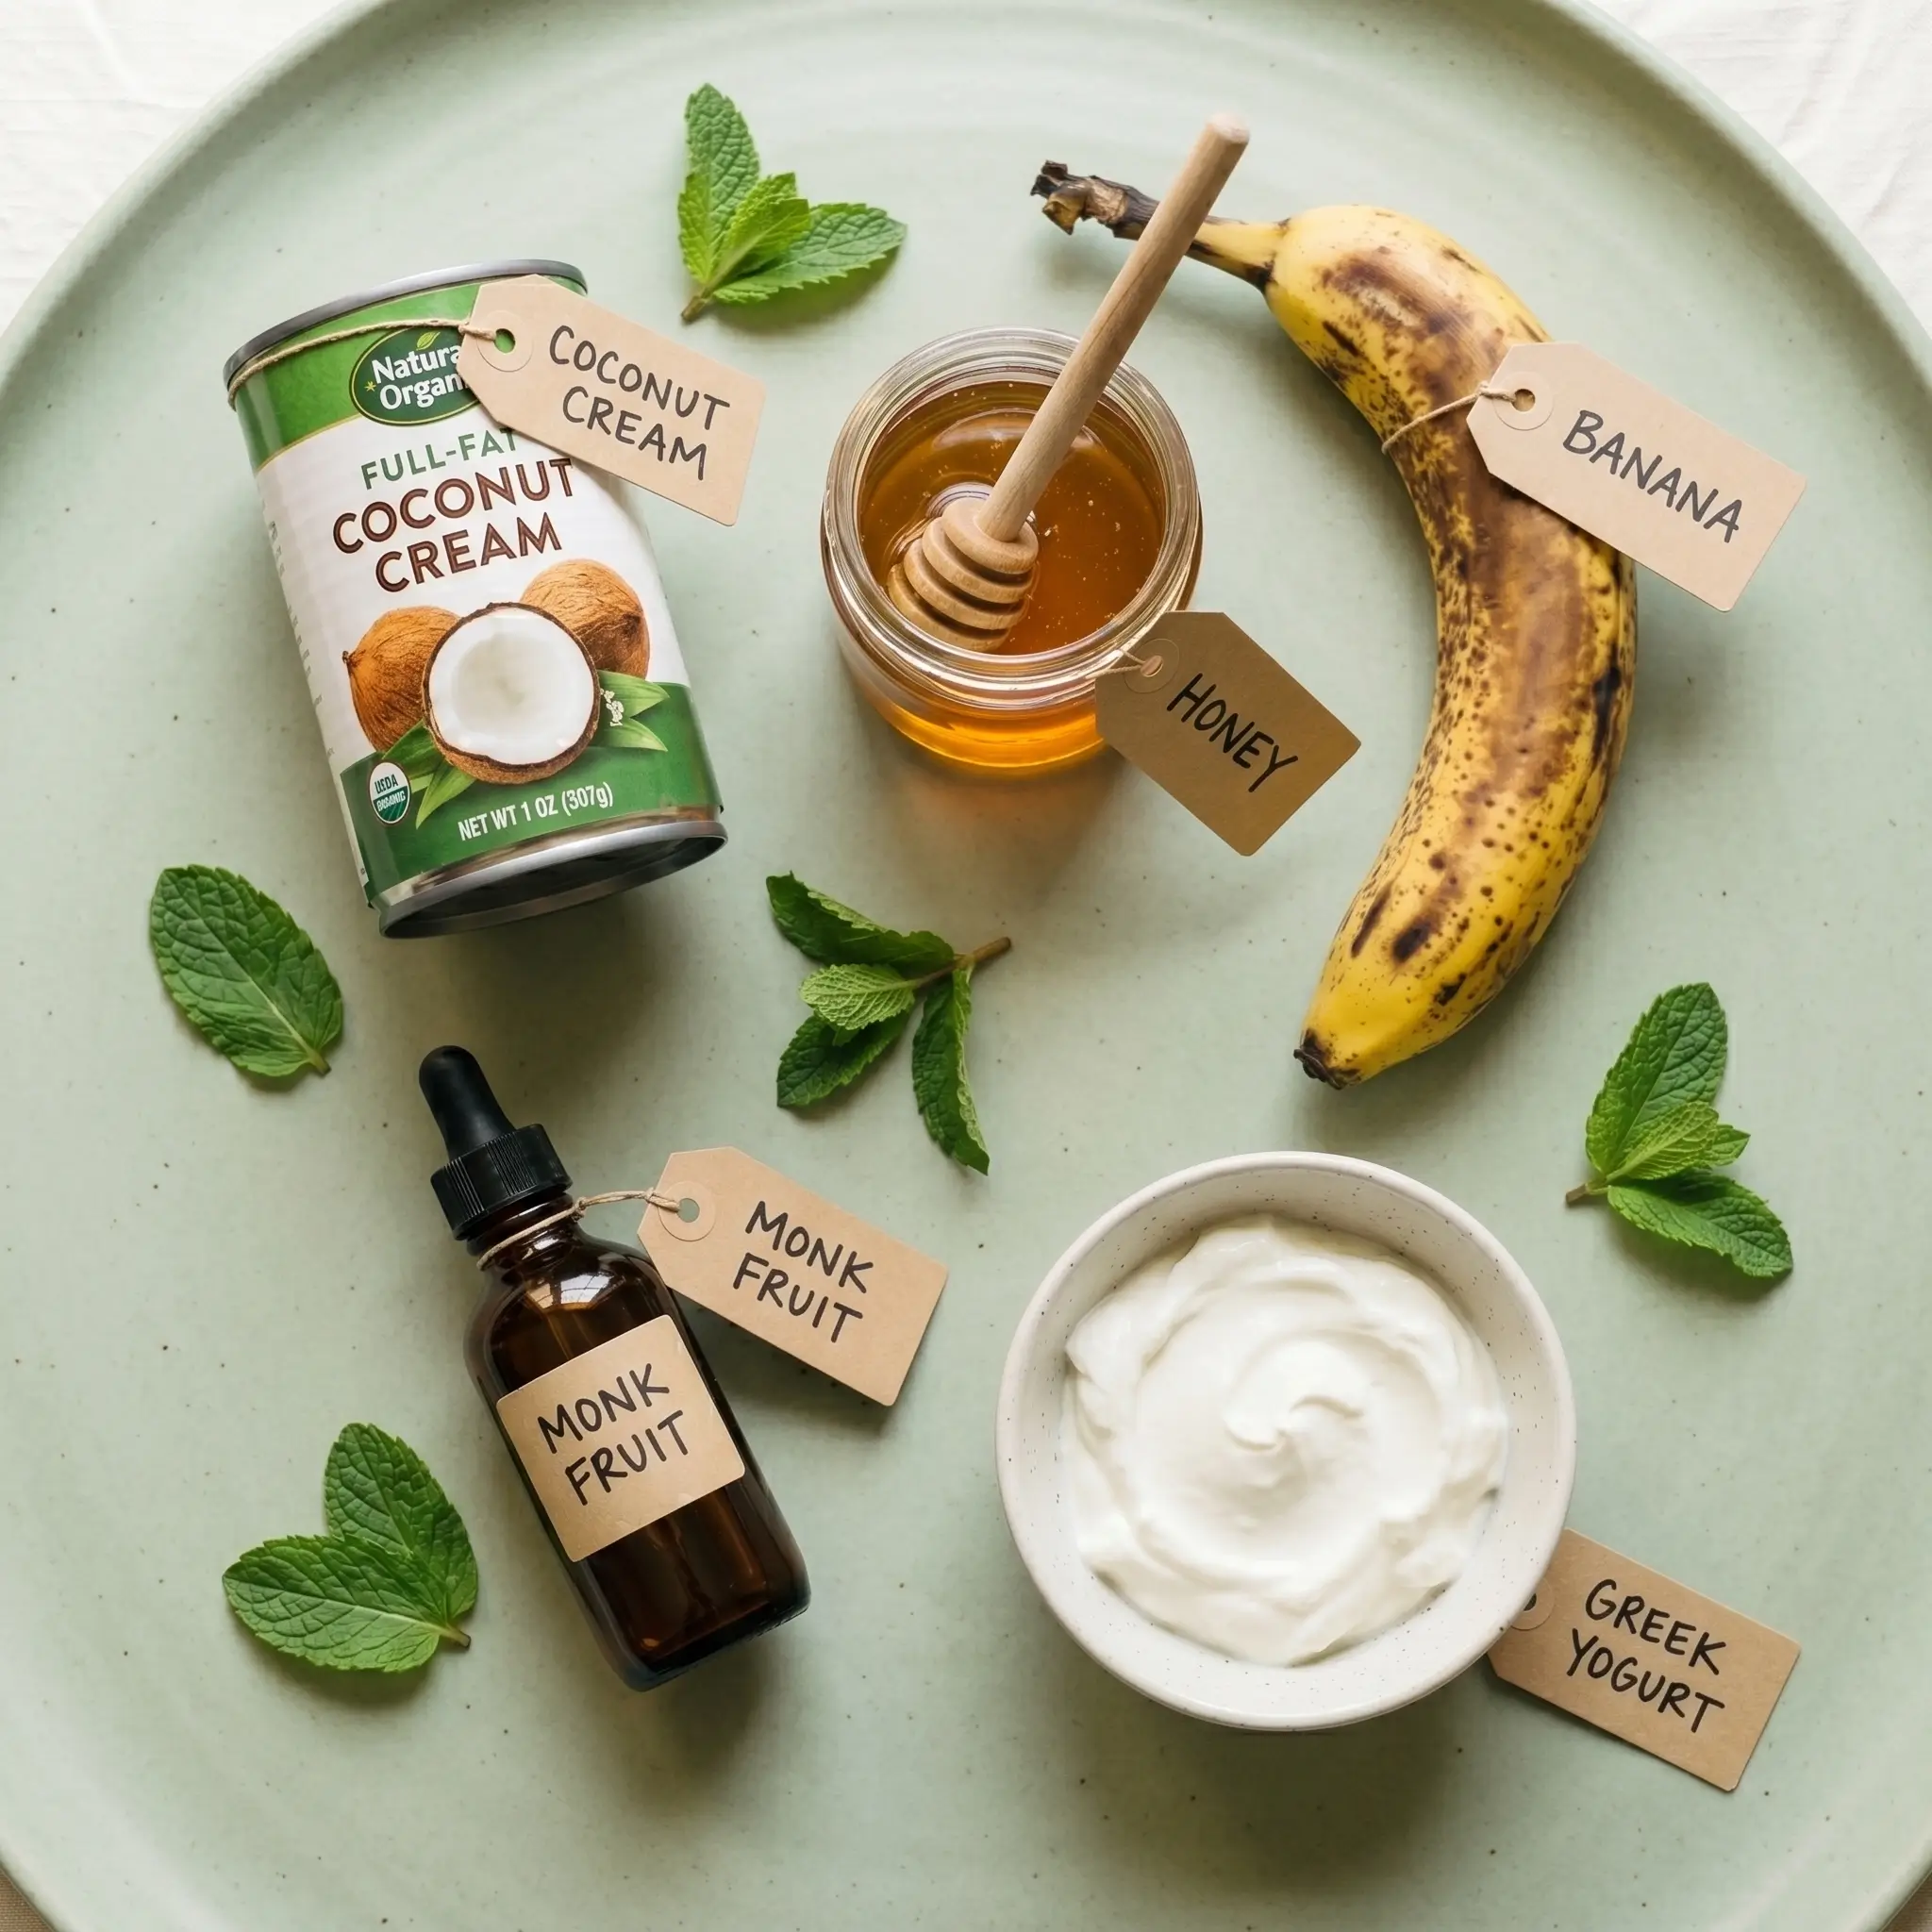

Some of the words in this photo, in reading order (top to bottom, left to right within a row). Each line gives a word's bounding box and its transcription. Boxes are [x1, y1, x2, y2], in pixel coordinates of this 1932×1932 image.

[372, 344, 460, 384] Natura
[379, 374, 469, 410] Organ
[549, 325, 730, 430] COCONUT
[361, 427, 516, 490] FULL-FAT
[562, 386, 707, 481] CREAM
[1562, 409, 1742, 543] BANANA
[333, 458, 574, 554] COCONUT
[375, 512, 562, 592] CREAM
[1166, 673, 1298, 792] HONEY
[458, 813, 488, 841] NET
[490, 805, 517, 830] WT
[521, 801, 531, 822] 1
[535, 794, 558, 818] OZ
[561, 781, 613, 817] (307g)
[745, 1201, 874, 1293] MONK
[733, 1252, 863, 1342] FRUIT
[537, 1363, 670, 1455] MONK
[565, 1409, 689, 1506] FRUIT
[1585, 1578, 1726, 1675] GREEK
[1566, 1627, 1725, 1733] YOGURT
